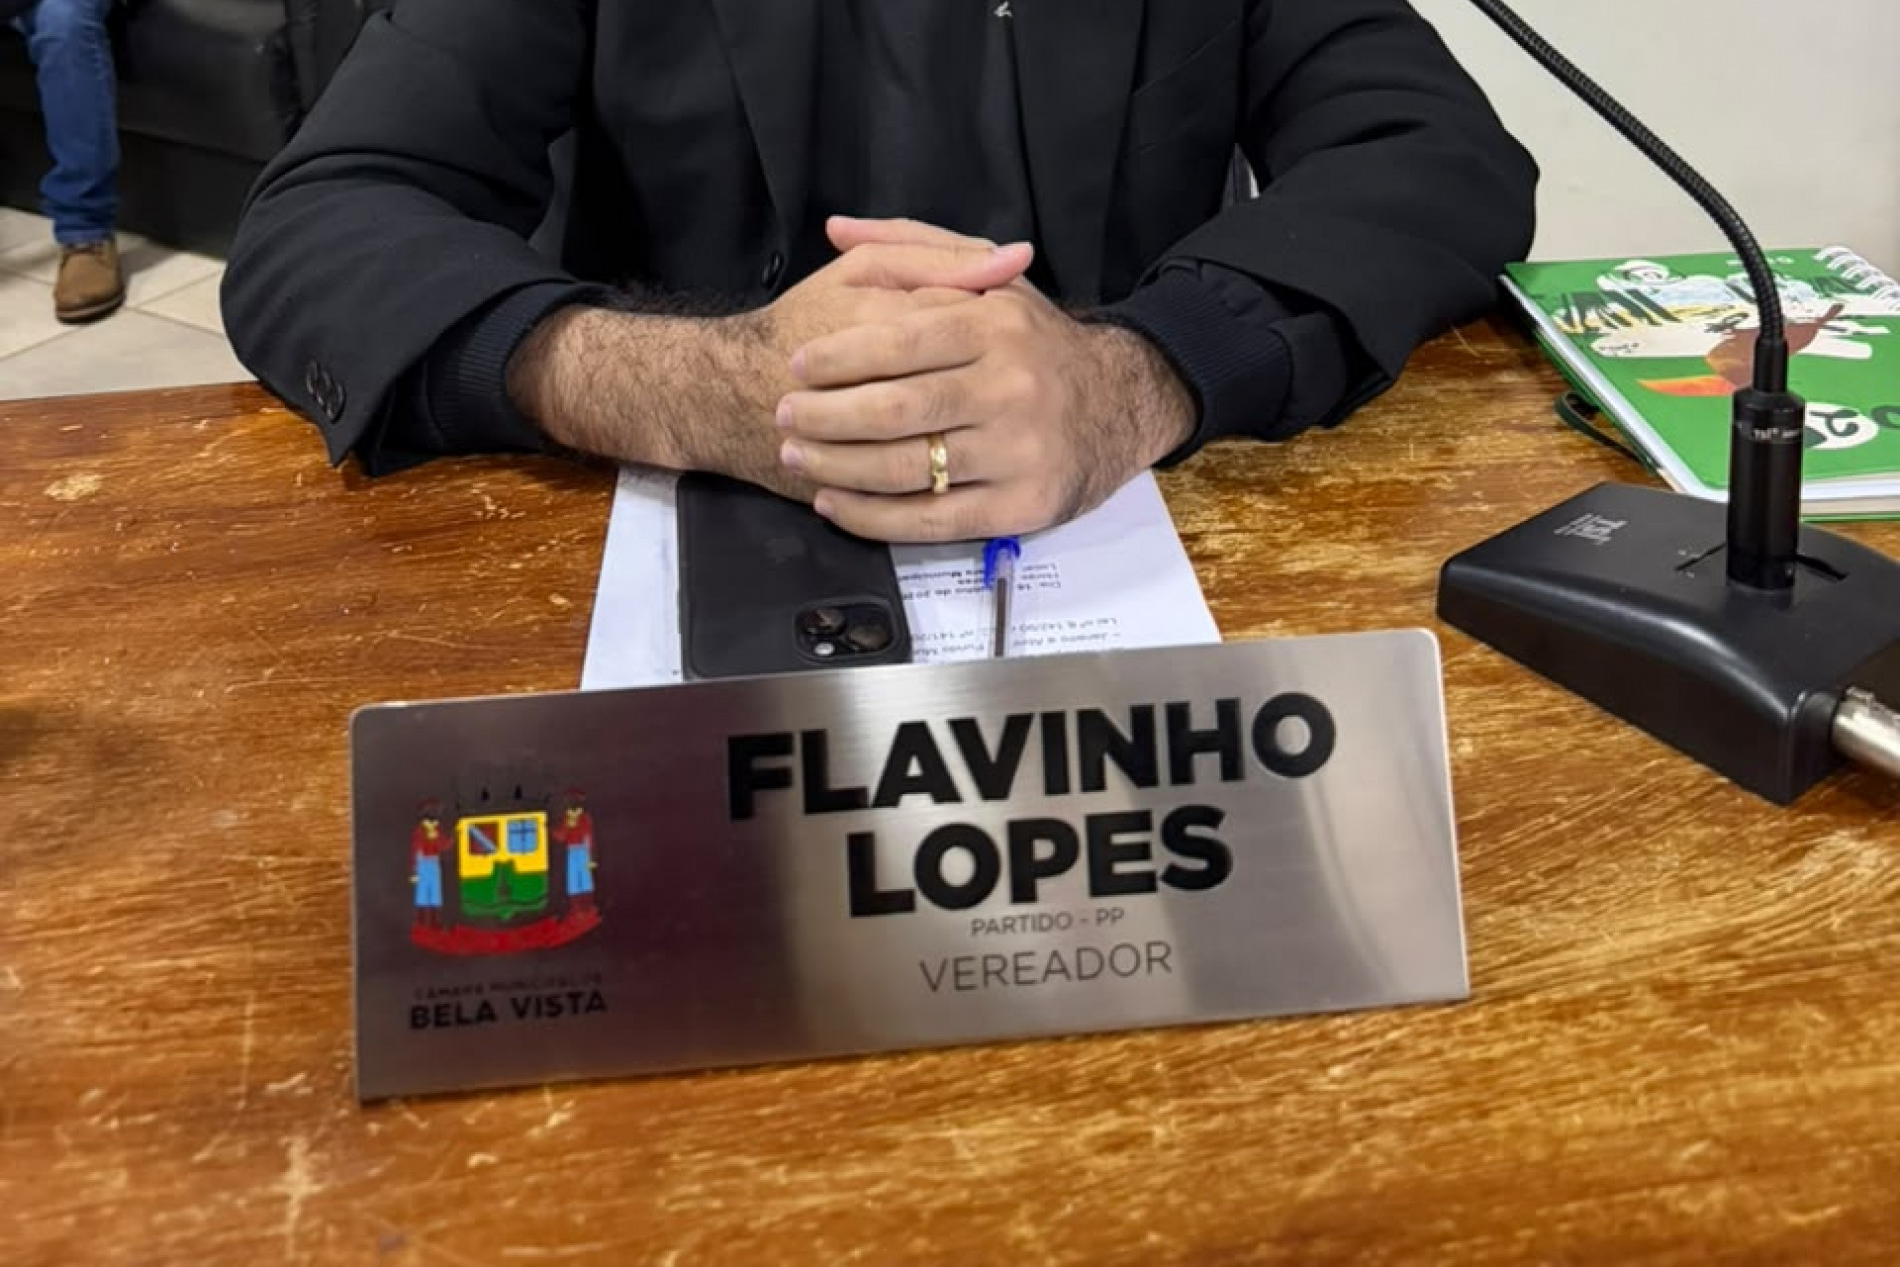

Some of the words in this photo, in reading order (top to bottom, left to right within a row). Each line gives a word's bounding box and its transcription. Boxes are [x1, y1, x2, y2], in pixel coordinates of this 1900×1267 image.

[728, 692, 1337, 821] FLAVINHO
[847, 805, 1233, 918] LOPES
[971, 911, 1074, 936] PARTIDO
[1095, 907, 1125, 925] PP
[919, 940, 1173, 994] VEREADOR
[410, 999, 499, 1030] BELA
[510, 989, 608, 1020] VISTA
